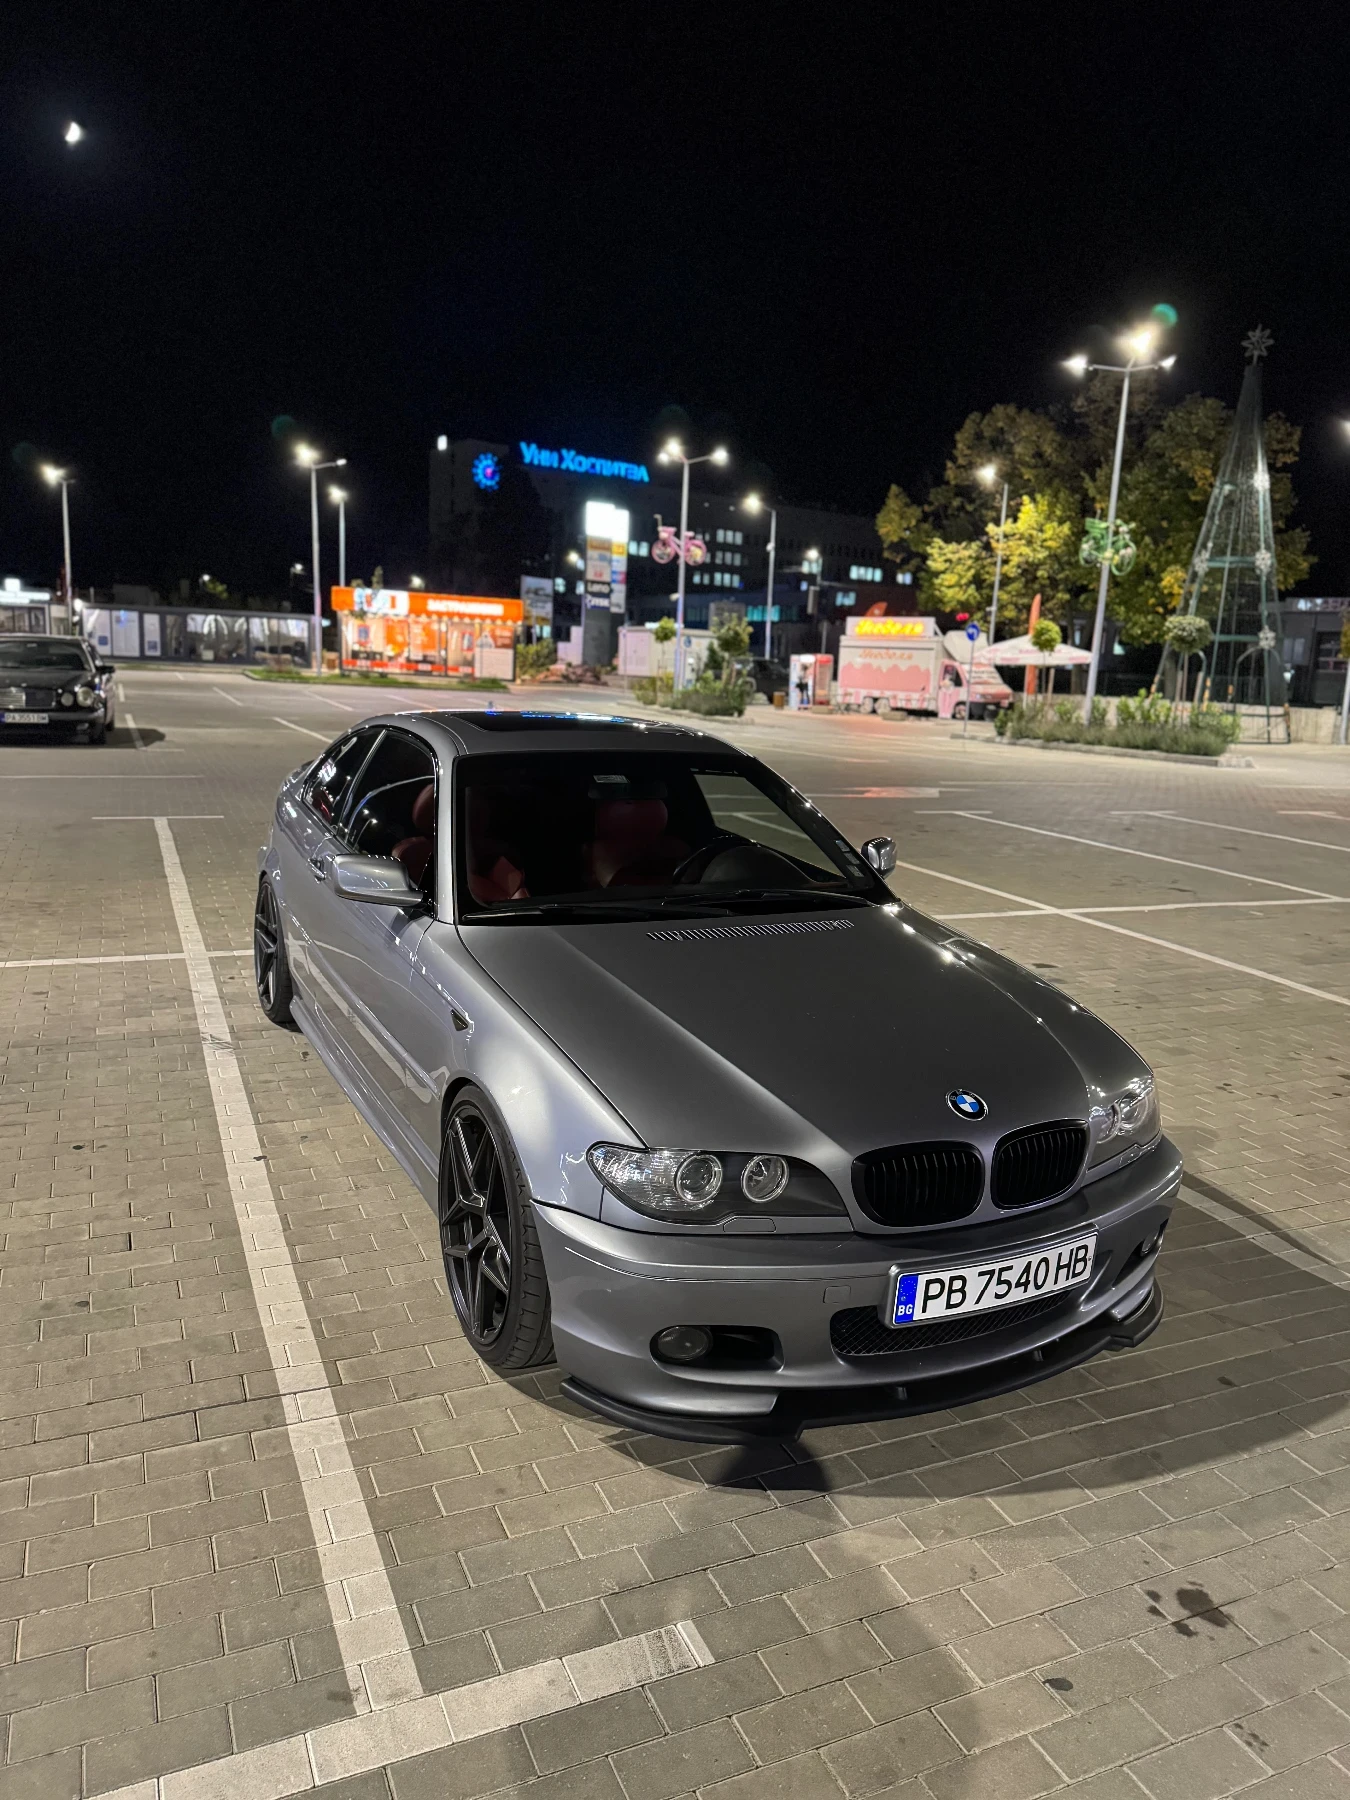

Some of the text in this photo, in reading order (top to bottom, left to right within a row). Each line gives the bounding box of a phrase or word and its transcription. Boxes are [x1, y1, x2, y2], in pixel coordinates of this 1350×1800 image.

[520, 441, 559, 468] Уни
[921, 1244, 1089, 1313] PB 7540 HB
[897, 1304, 913, 1316] BG
